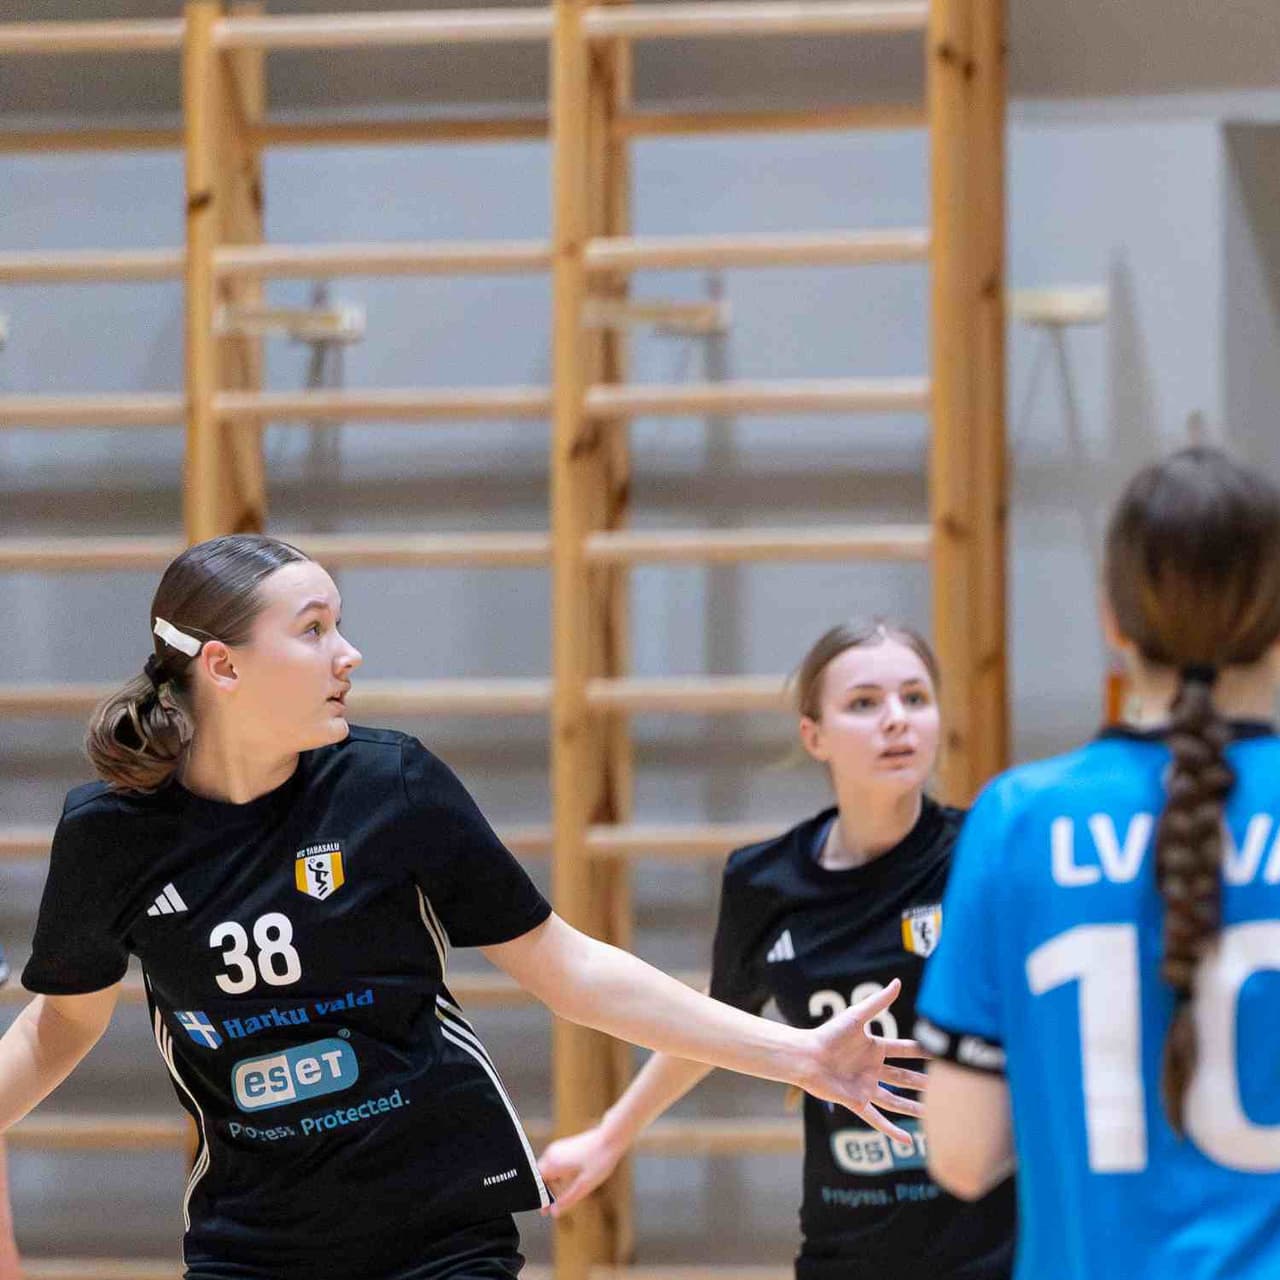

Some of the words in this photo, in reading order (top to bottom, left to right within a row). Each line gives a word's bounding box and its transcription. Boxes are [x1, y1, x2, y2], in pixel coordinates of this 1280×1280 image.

[209, 911, 302, 995] 38
[222, 1008, 310, 1039] Harku
[315, 989, 375, 1016] vald
[301, 1089, 410, 1134] Protected.
